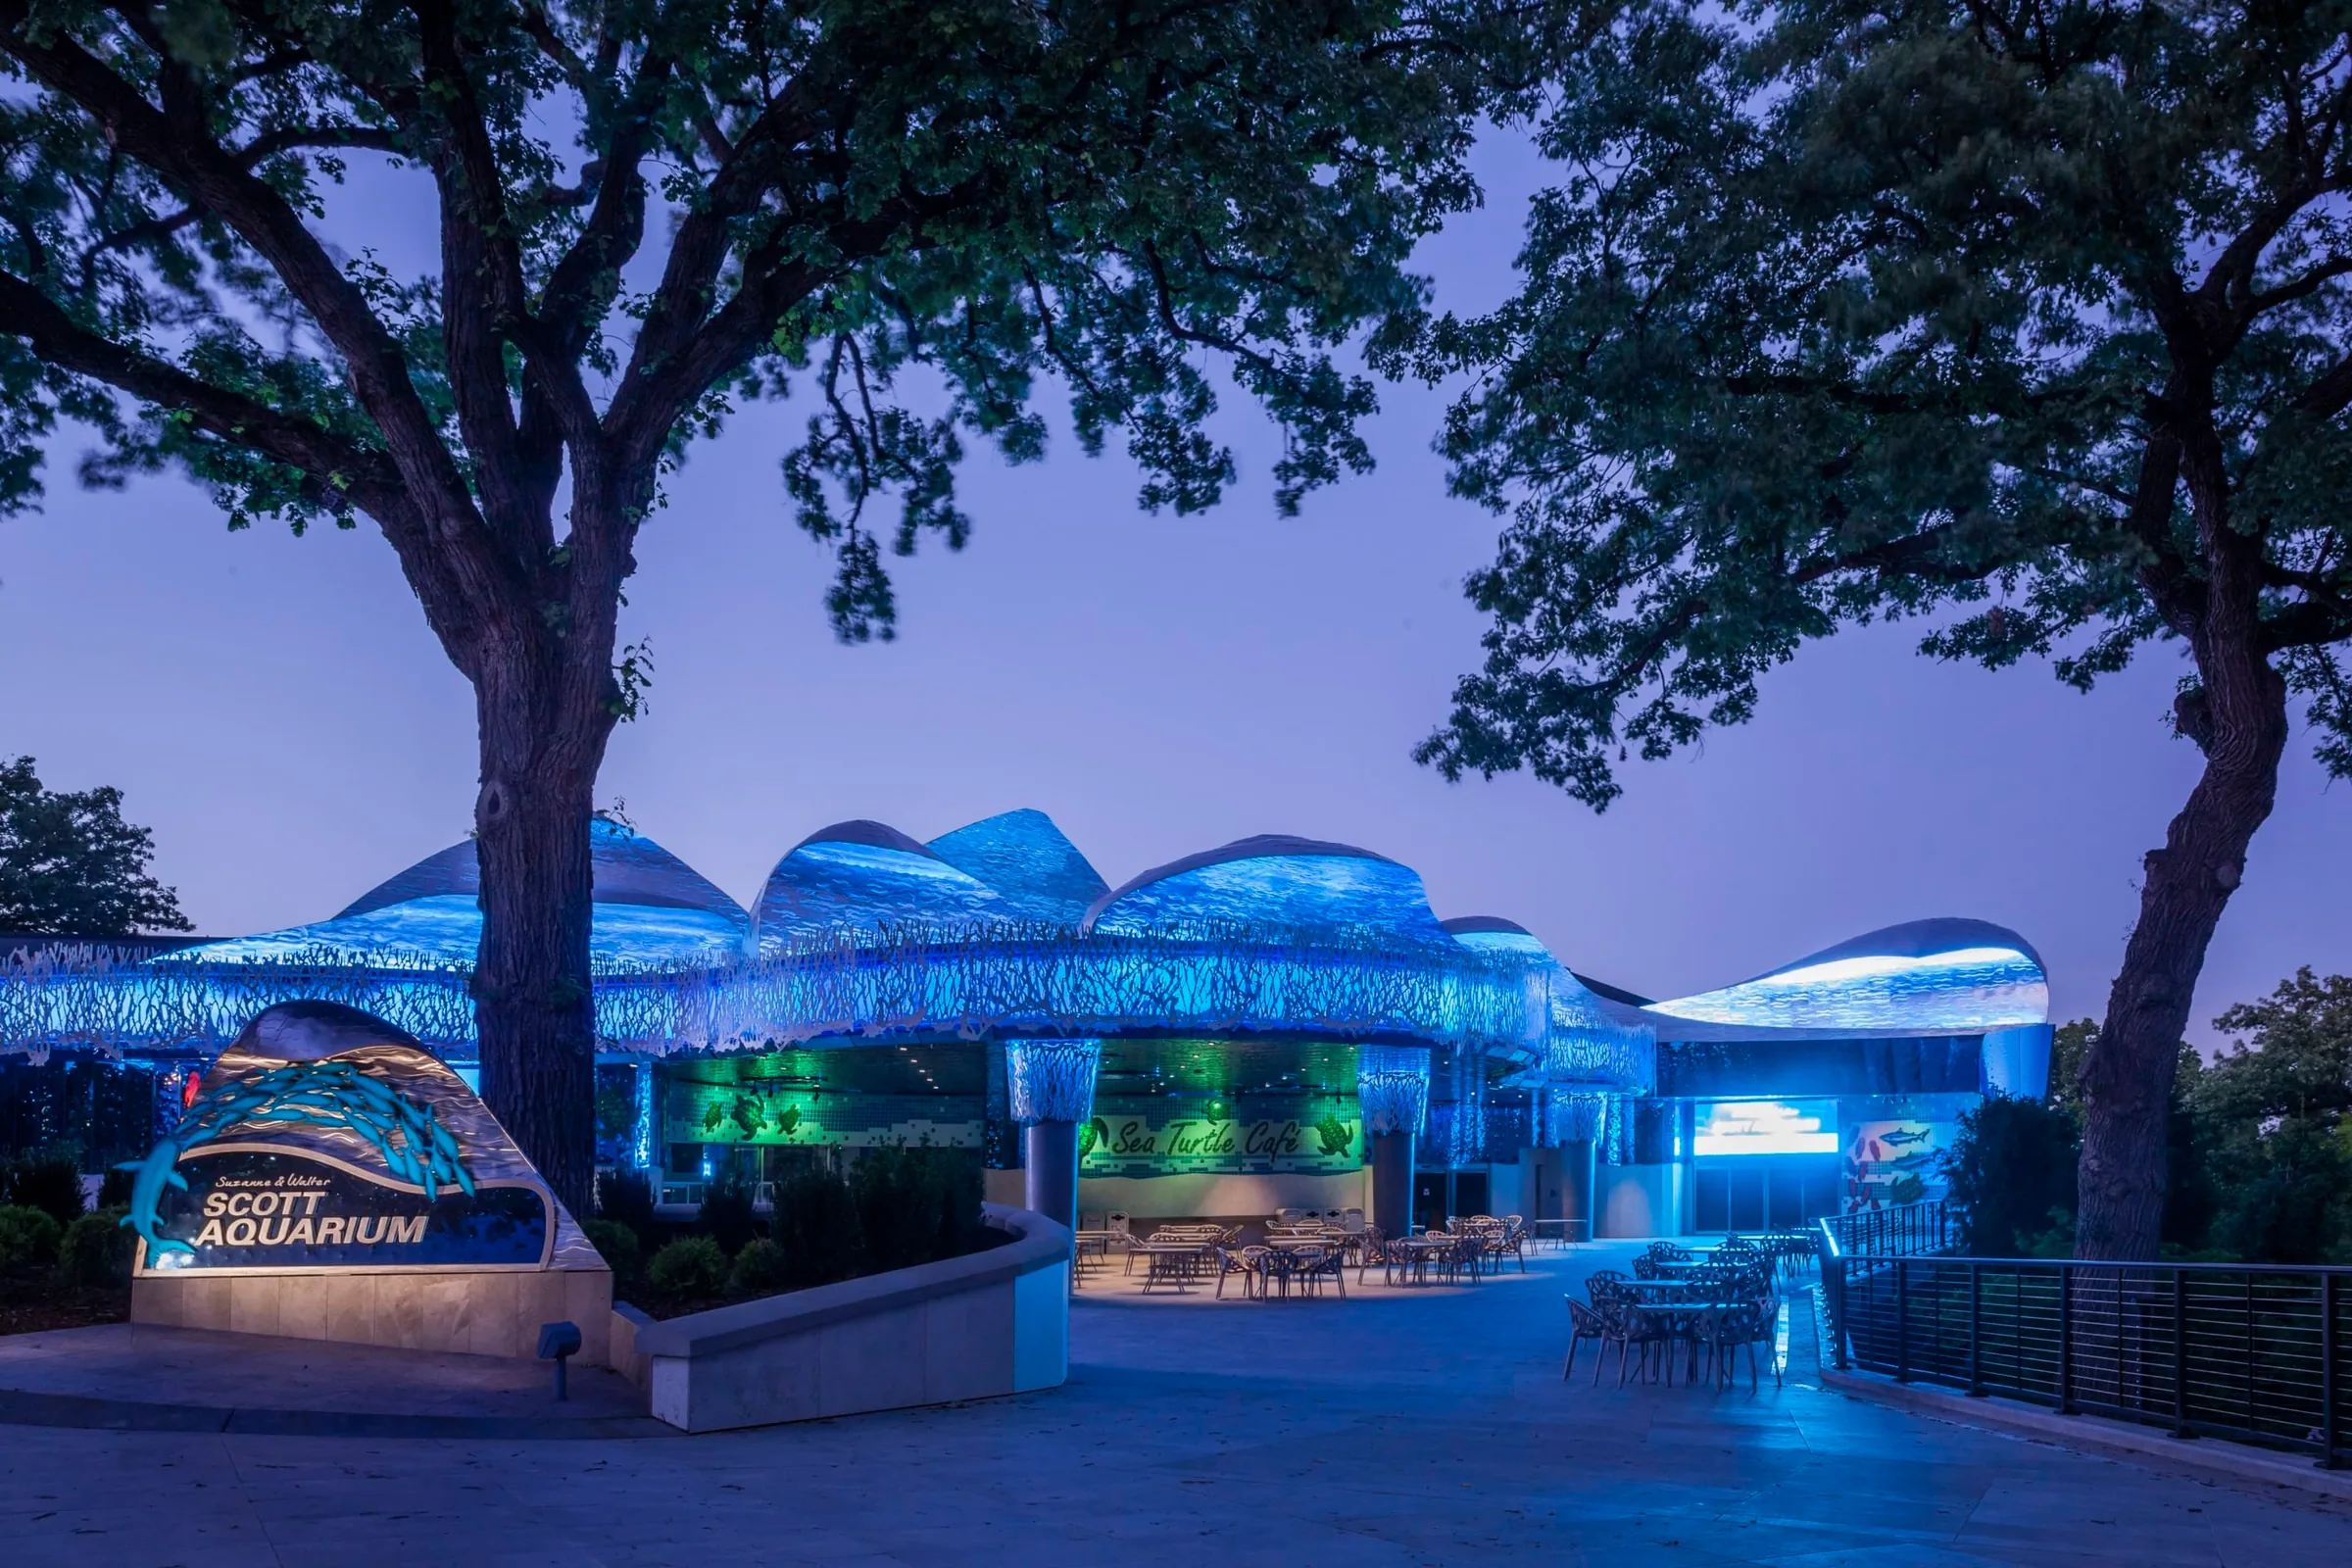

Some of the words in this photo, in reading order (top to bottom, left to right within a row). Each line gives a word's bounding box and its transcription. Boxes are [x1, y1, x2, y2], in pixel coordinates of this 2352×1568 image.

[1111, 1121, 1154, 1154] Sea
[1167, 1121, 1235, 1155] Turtle
[1245, 1120, 1299, 1161] Café
[216, 1176, 271, 1188] Suzanne
[274, 1176, 284, 1187] &
[287, 1173, 330, 1187] Walter
[203, 1191, 326, 1216] SCOTT
[194, 1216, 428, 1247] AQUARIUM
